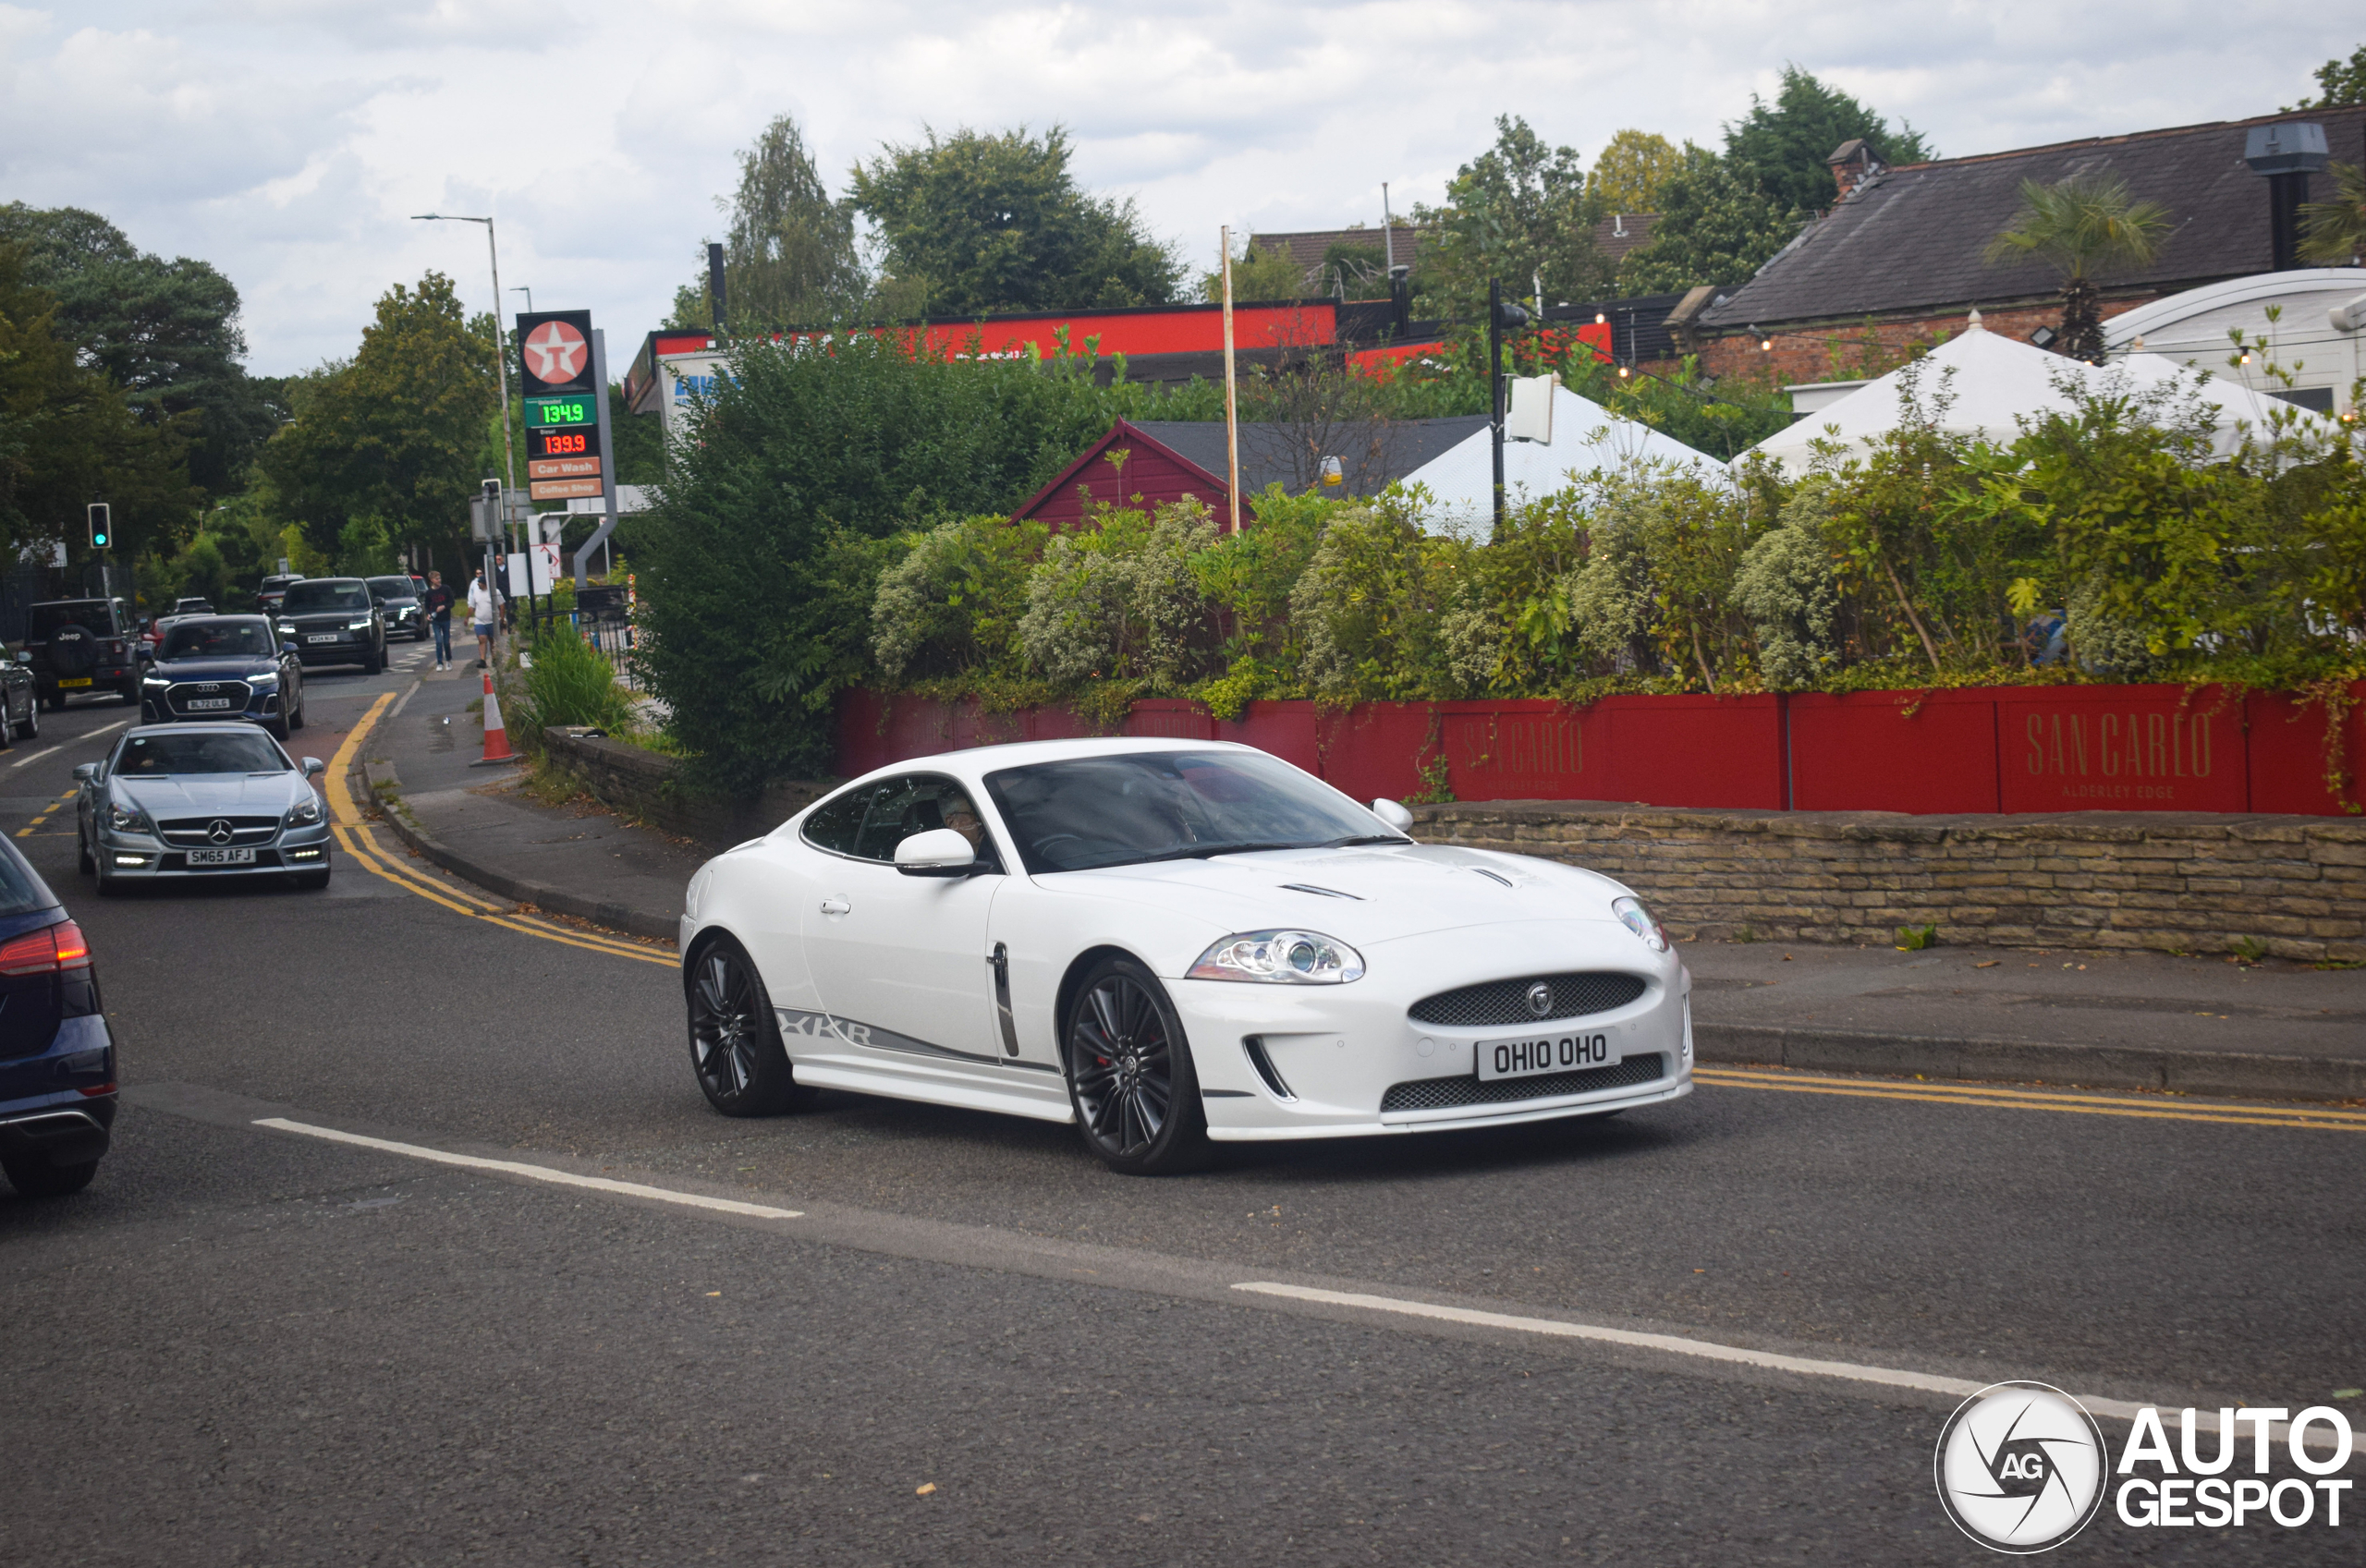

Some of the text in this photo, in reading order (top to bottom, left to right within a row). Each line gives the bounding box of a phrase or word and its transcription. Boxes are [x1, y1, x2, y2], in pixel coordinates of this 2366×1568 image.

[543, 404, 583, 423] 134.9
[545, 434, 586, 454] 139.9
[538, 462, 592, 474] Car Wash
[539, 484, 594, 494] Coffee Shop
[212, 699, 227, 708] ULG
[1511, 722, 1582, 773] CARLO
[2027, 712, 2210, 777] SAN CARLO
[2062, 785, 2174, 799] ALDERLEY EDGE
[191, 849, 250, 862] SM65 AFJ
[776, 1012, 872, 1045] XKR
[1494, 1034, 1606, 1073] OH10 OHO
